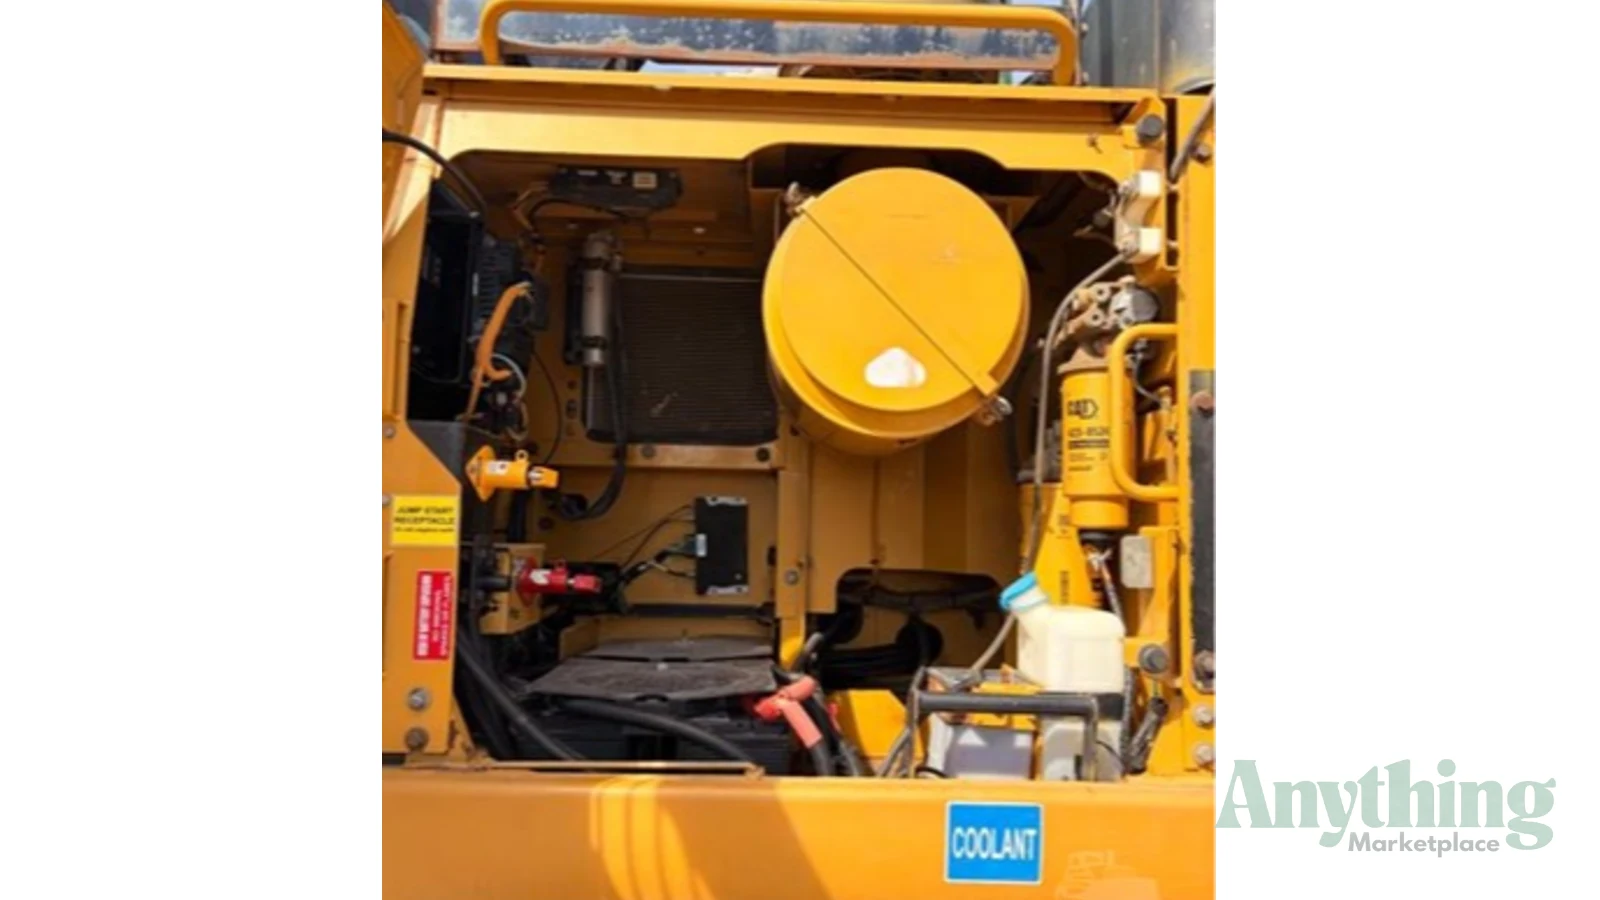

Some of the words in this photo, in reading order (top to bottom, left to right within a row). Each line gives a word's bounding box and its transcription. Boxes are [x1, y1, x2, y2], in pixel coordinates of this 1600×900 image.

[396, 506, 422, 514] JUMP
[425, 506, 454, 514] START
[394, 516, 454, 525] RECEPTACLE
[952, 826, 1038, 861] COOLANT
